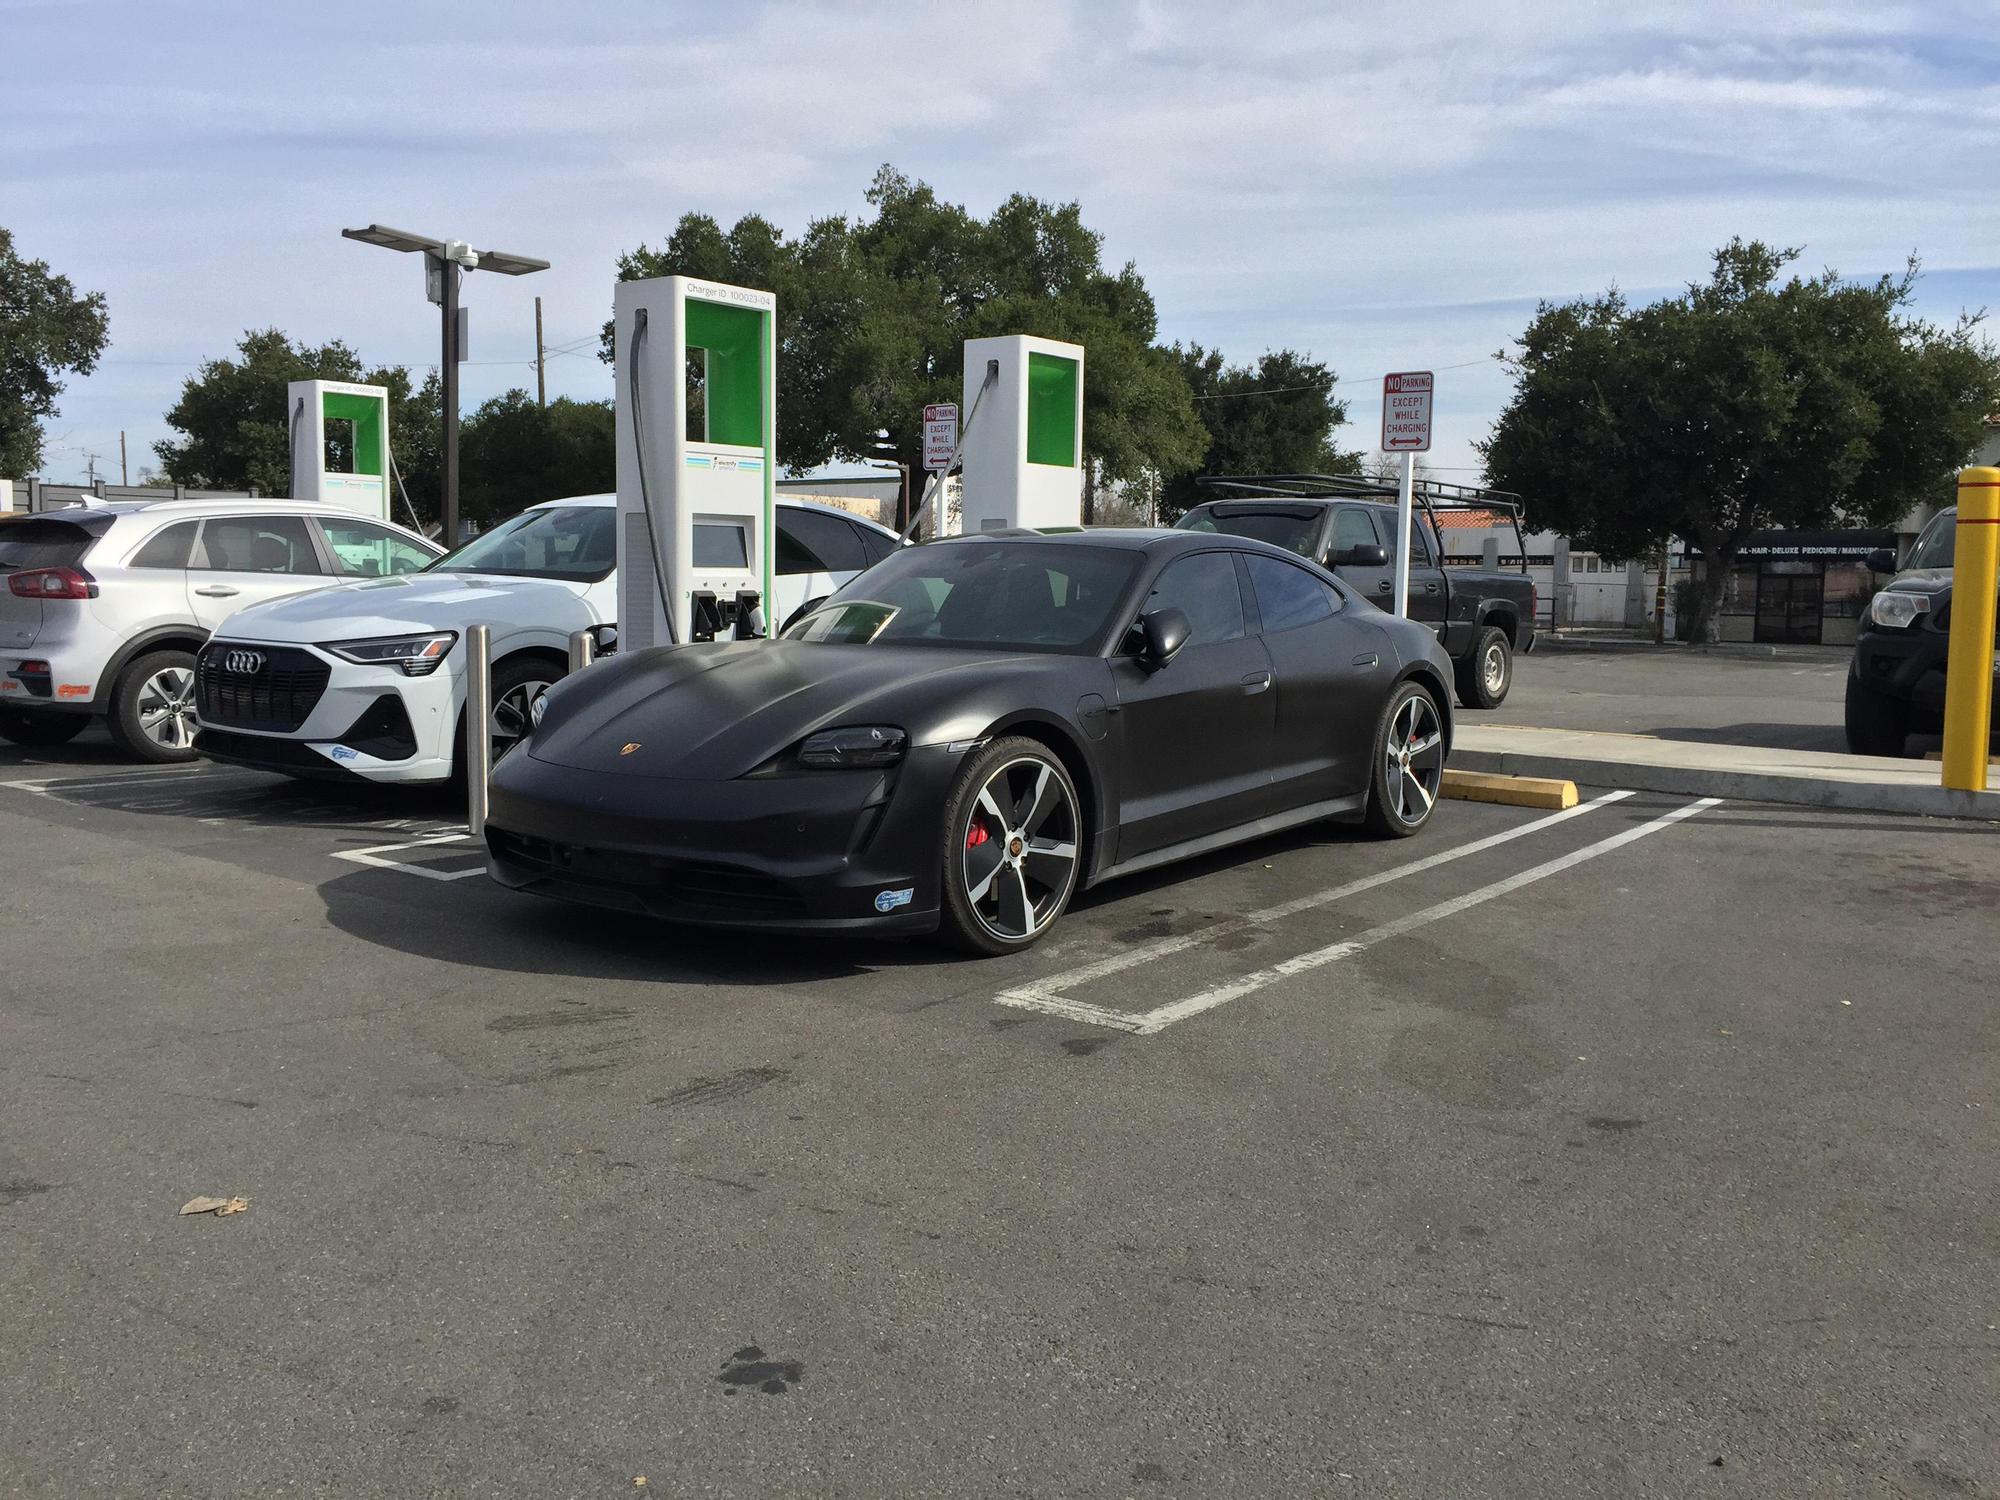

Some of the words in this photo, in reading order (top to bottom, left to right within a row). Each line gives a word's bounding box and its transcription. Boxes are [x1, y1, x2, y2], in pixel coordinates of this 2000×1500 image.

[687, 283, 717, 297] Charger
[1387, 377, 1400, 391] NO
[1402, 377, 1430, 389] PARKING
[1392, 397, 1424, 407] EXCEPT
[926, 408, 936, 420] NO
[936, 408, 955, 417] PARKING
[1394, 410, 1420, 420] WHILE
[930, 425, 951, 433] EXCEPT
[1386, 423, 1427, 433] CHARGING
[932, 435, 949, 443] WHILE
[927, 446, 954, 455] CHARGING
[1772, 547, 1799, 555] DELUXE
[1802, 547, 1837, 555] PEDICURE
